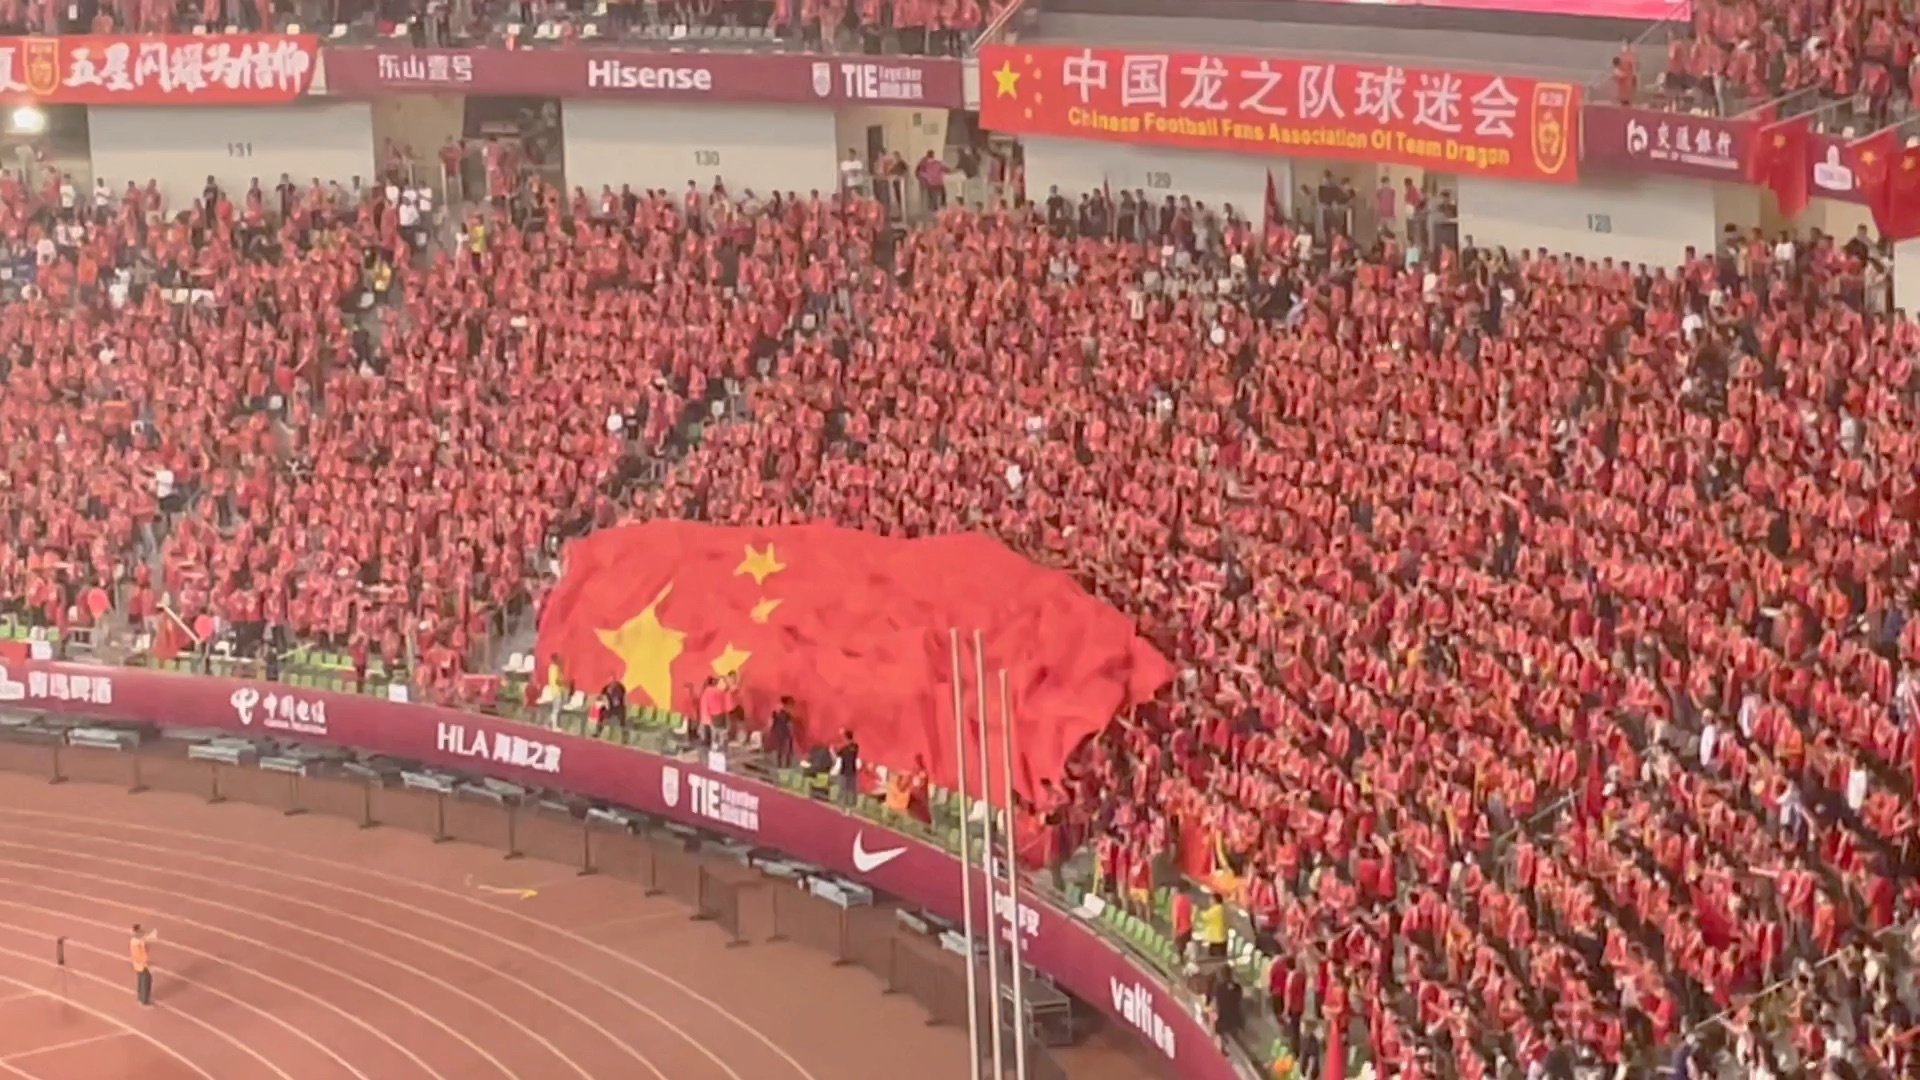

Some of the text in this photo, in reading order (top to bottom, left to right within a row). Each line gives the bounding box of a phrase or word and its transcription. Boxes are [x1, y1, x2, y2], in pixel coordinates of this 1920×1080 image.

[588, 59, 712, 91] Hisense
[841, 63, 878, 98] TIE
[1062, 47, 1520, 139] 中国龙之队球迷会
[1068, 106, 1510, 169] Chinese Football Fans Association Of Team Dragon
[437, 721, 489, 759] HLA
[688, 773, 720, 819] TIE
